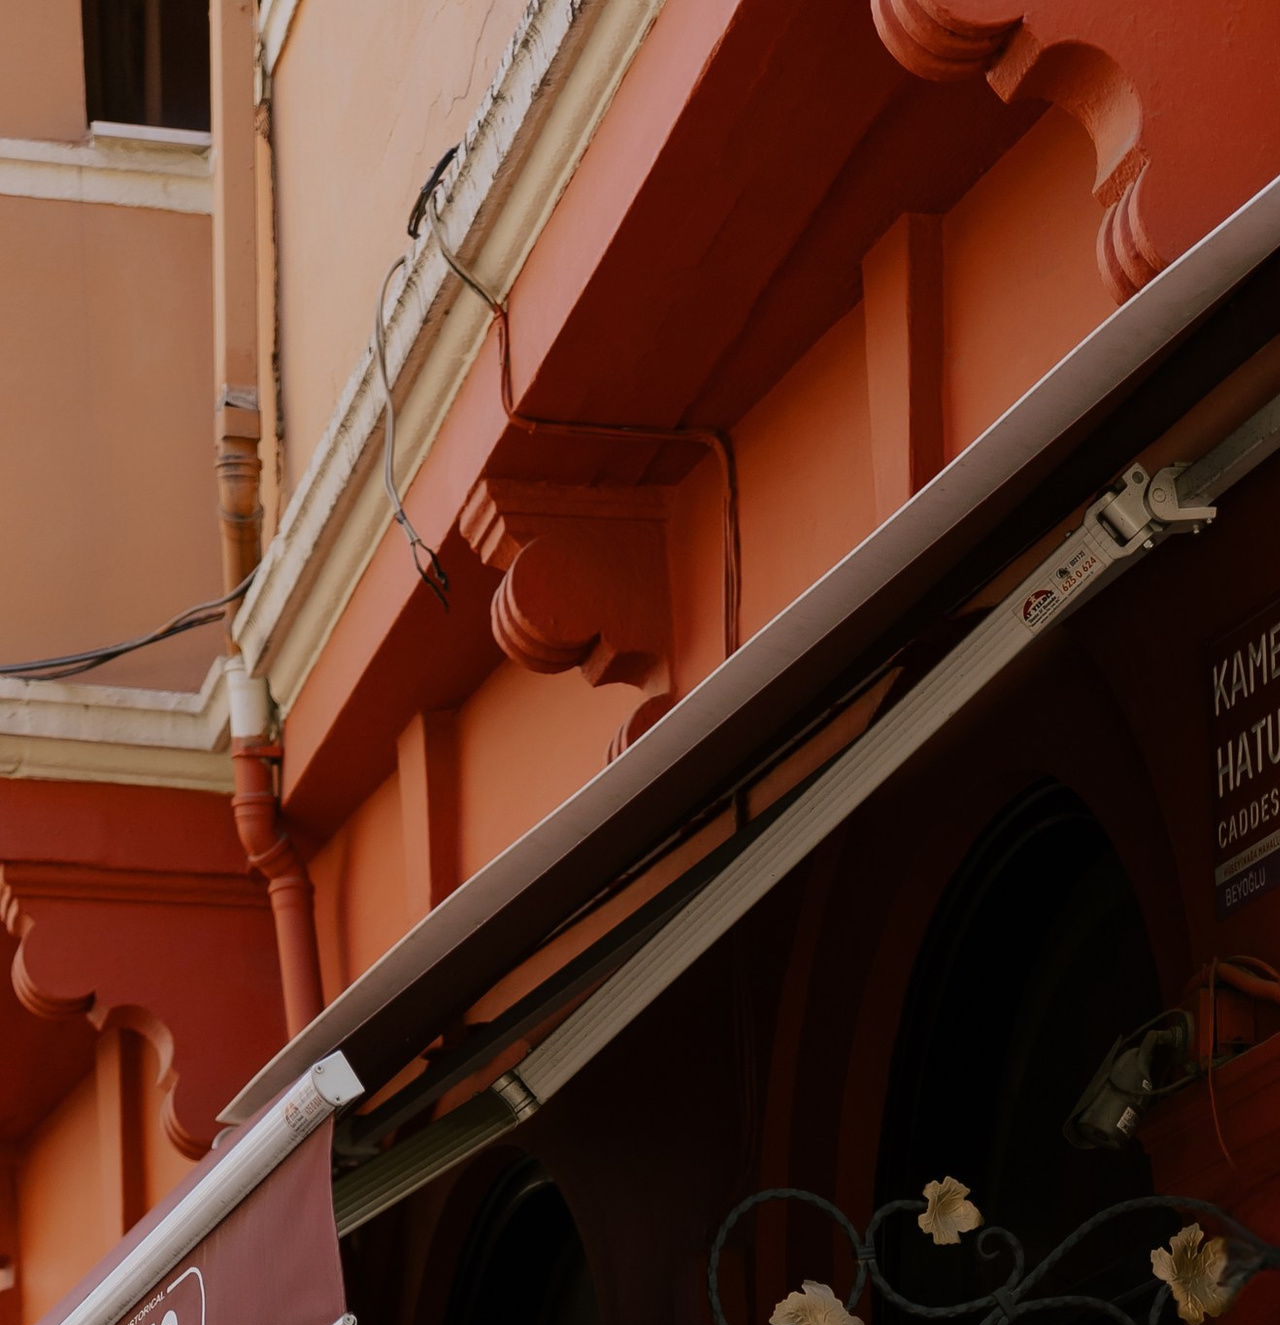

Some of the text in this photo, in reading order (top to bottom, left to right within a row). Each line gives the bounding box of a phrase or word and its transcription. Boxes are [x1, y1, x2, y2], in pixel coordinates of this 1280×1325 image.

[1062, 576, 1077, 592] 625
[1081, 556, 1097, 573] 624
[1225, 867, 1266, 908] BEYOĞLU
